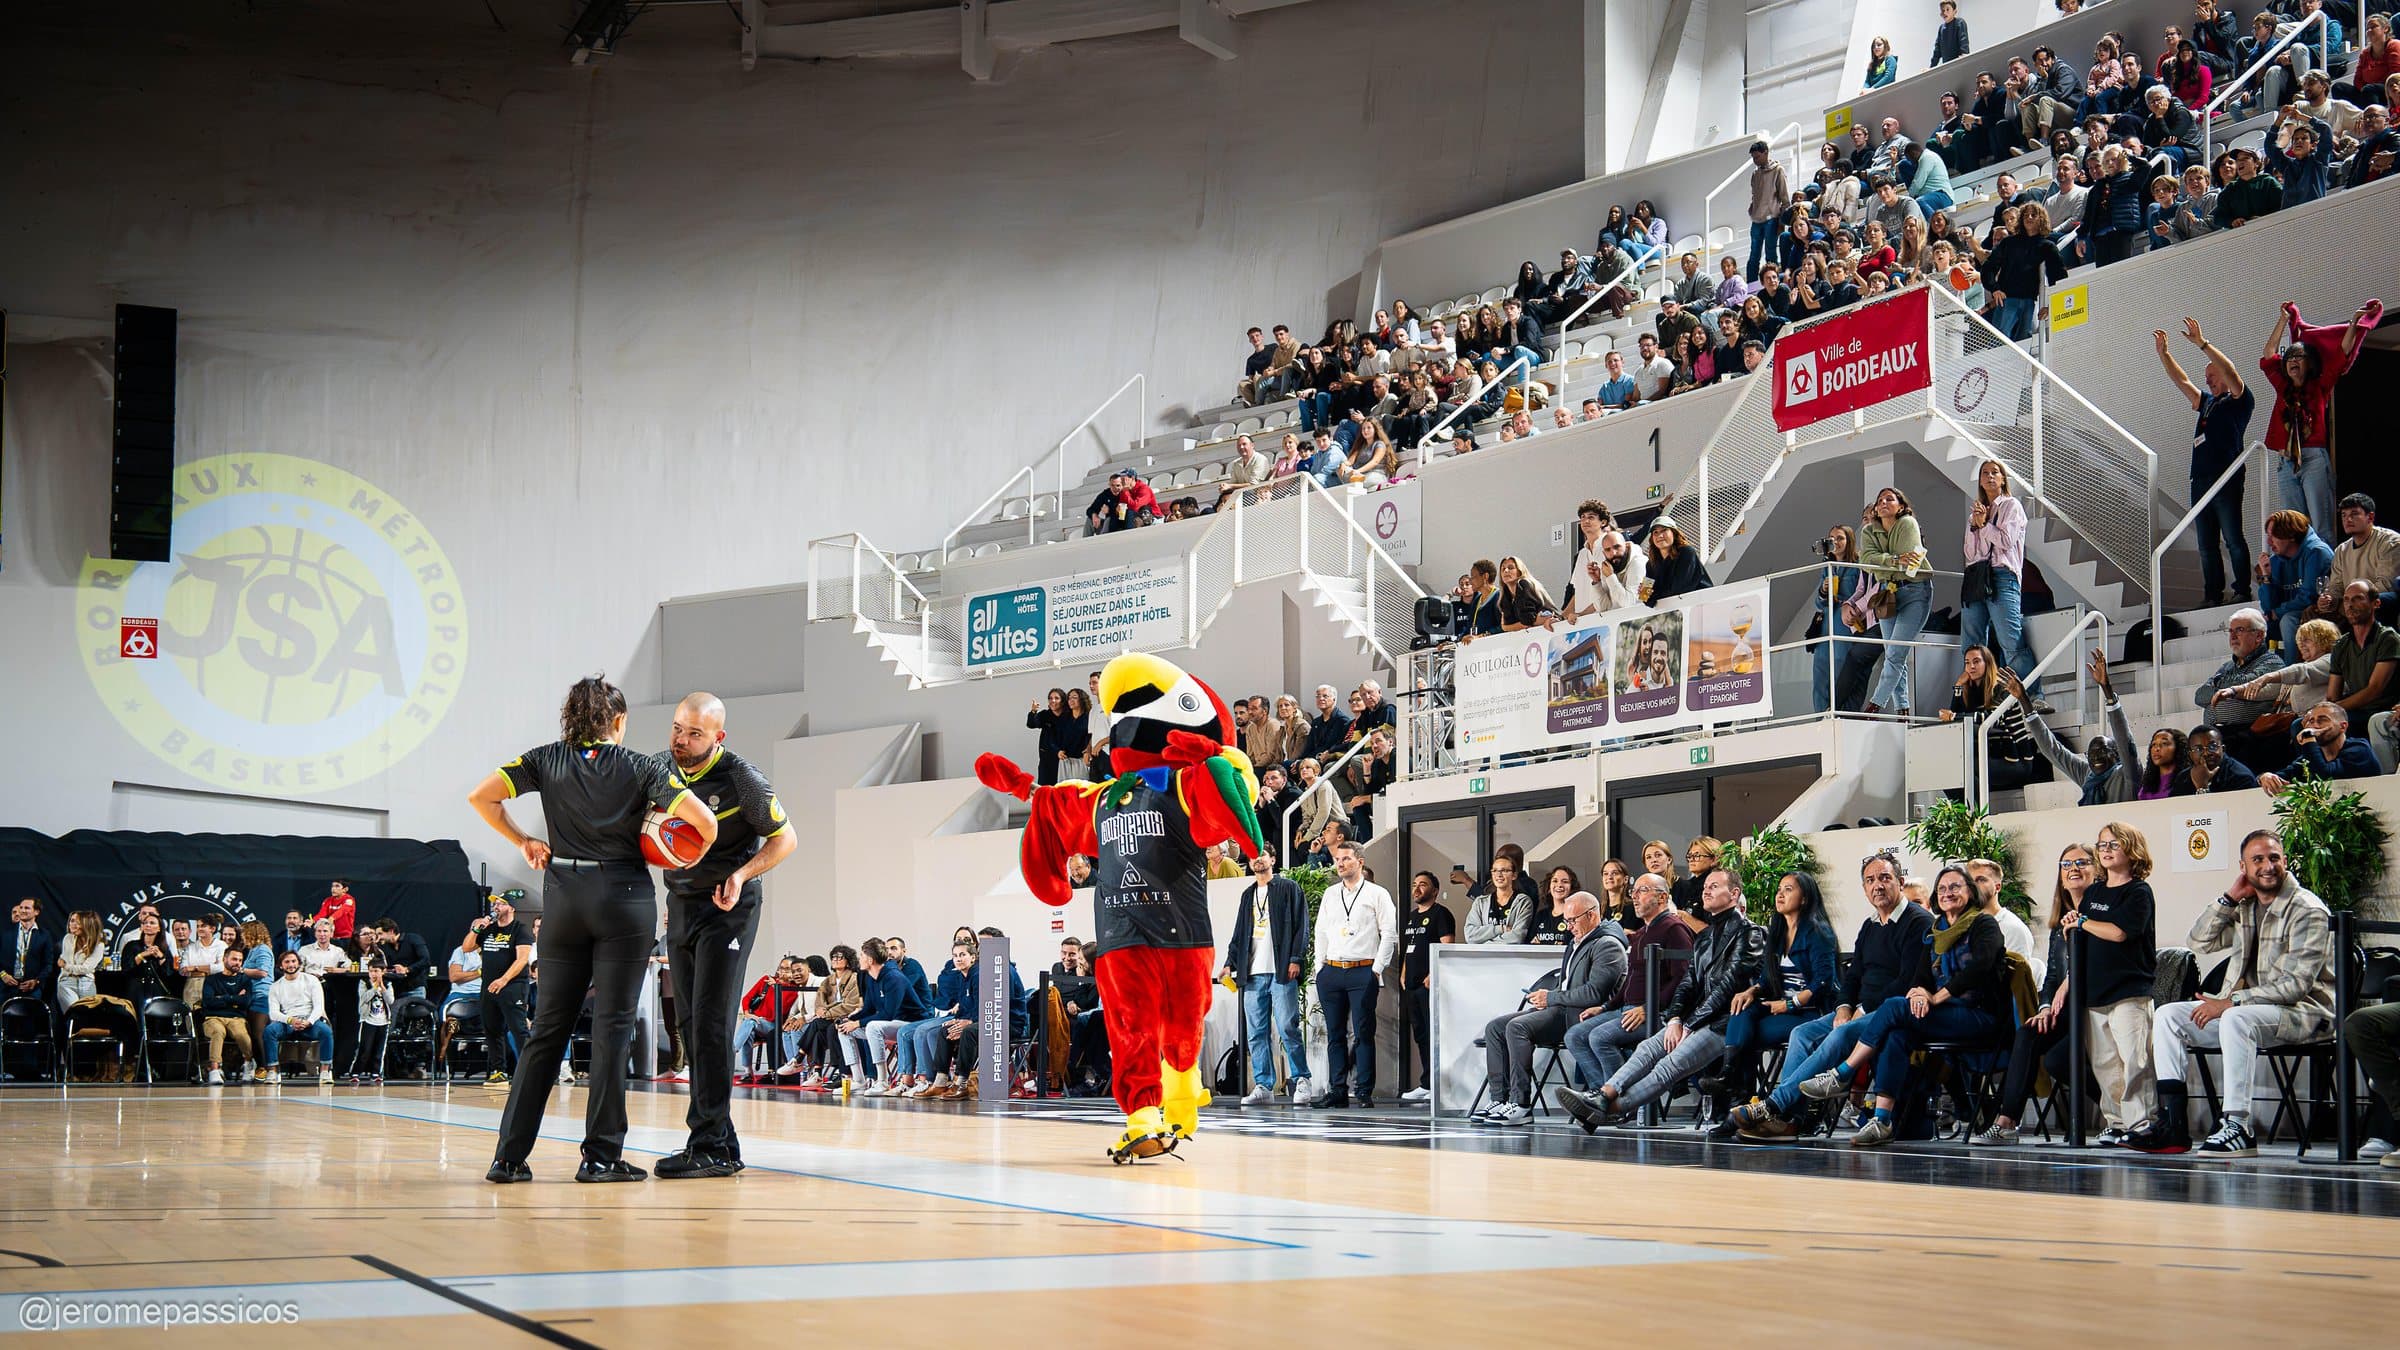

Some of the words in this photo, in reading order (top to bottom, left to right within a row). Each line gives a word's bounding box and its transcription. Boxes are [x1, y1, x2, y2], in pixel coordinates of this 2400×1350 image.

[1820, 343, 1846, 363] Ville
[1848, 336, 1863, 352] de
[1822, 341, 1919, 397] BORDEAUX
[1648, 427, 1660, 472] 1
[1052, 583, 1066, 594] SUR
[1103, 573, 1137, 586] BORDEAUX
[1052, 593, 1089, 606] BORDEAUX
[1090, 589, 1115, 601] CENTRE
[1115, 587, 1125, 596] OU
[1126, 581, 1152, 595] ENCORE
[349, 488, 460, 726] MÉTROPOLE
[1013, 592, 1039, 605] APPART
[1017, 603, 1039, 615] HÔTEL
[1053, 604, 1107, 621] SÉJOURNEZ
[1109, 598, 1133, 612] DANS
[1135, 595, 1147, 607] LE
[157, 551, 409, 700] JSA
[973, 599, 998, 633] all
[1053, 624, 1070, 637] ALL
[1071, 618, 1104, 634] SUITES
[1105, 613, 1140, 630] APPART
[1142, 606, 1172, 622] HÔTEL
[971, 626, 1038, 660] suites
[1052, 640, 1065, 652] DE
[1066, 635, 1097, 650] VOTRE
[1099, 629, 1127, 644] CHOIX
[1463, 654, 1521, 678] AQUILOGIA
[1698, 681, 1730, 694] OPTIMISER
[1730, 678, 1752, 690] VOTRE
[1709, 692, 1739, 704] ÉPARGNE
[1553, 705, 1585, 719] DÉVELOPPER
[1586, 702, 1603, 713] VOTRE
[1620, 700, 1646, 713] RÉDUIRE
[1646, 699, 1658, 709] VOS
[1562, 716, 1593, 728] PATRIMOINE
[161, 727, 346, 786] BASKET
[2190, 818, 2213, 826] LOGE
[985, 1001, 993, 1036] LOGES
[993, 955, 1003, 1082] PRÉSIDENTIELLES
